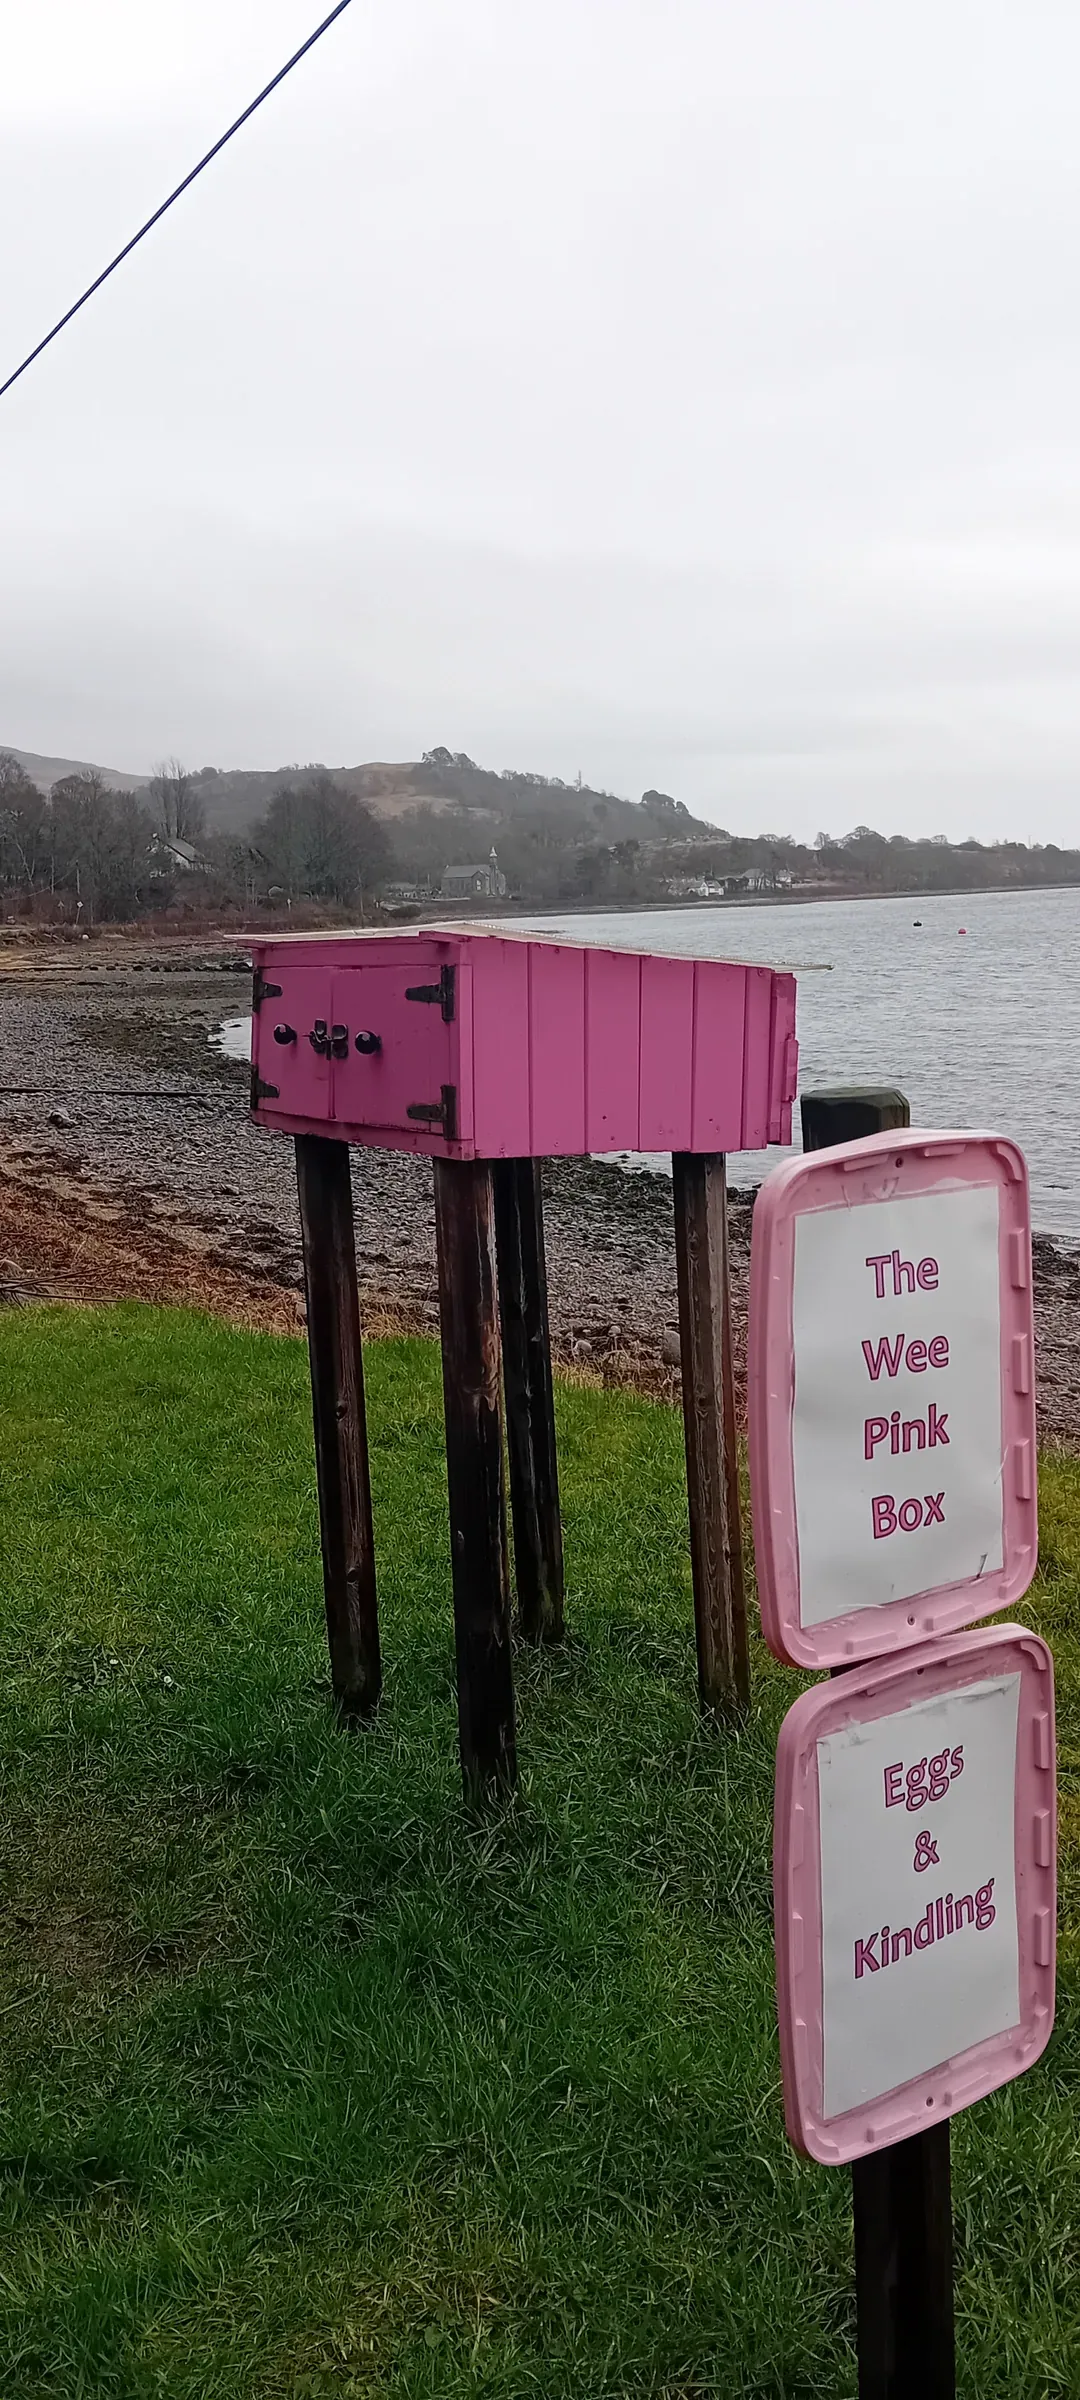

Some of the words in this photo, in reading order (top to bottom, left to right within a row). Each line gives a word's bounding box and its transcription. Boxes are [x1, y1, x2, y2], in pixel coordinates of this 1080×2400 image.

[866, 1250, 939, 1298] The
[861, 1334, 949, 1380] Wee
[864, 1403, 950, 1459] Pink
[871, 1492, 945, 1540] Box
[883, 1744, 964, 1812] Eggs
[913, 1830, 940, 1872] &
[854, 1878, 996, 1979] Kindling
